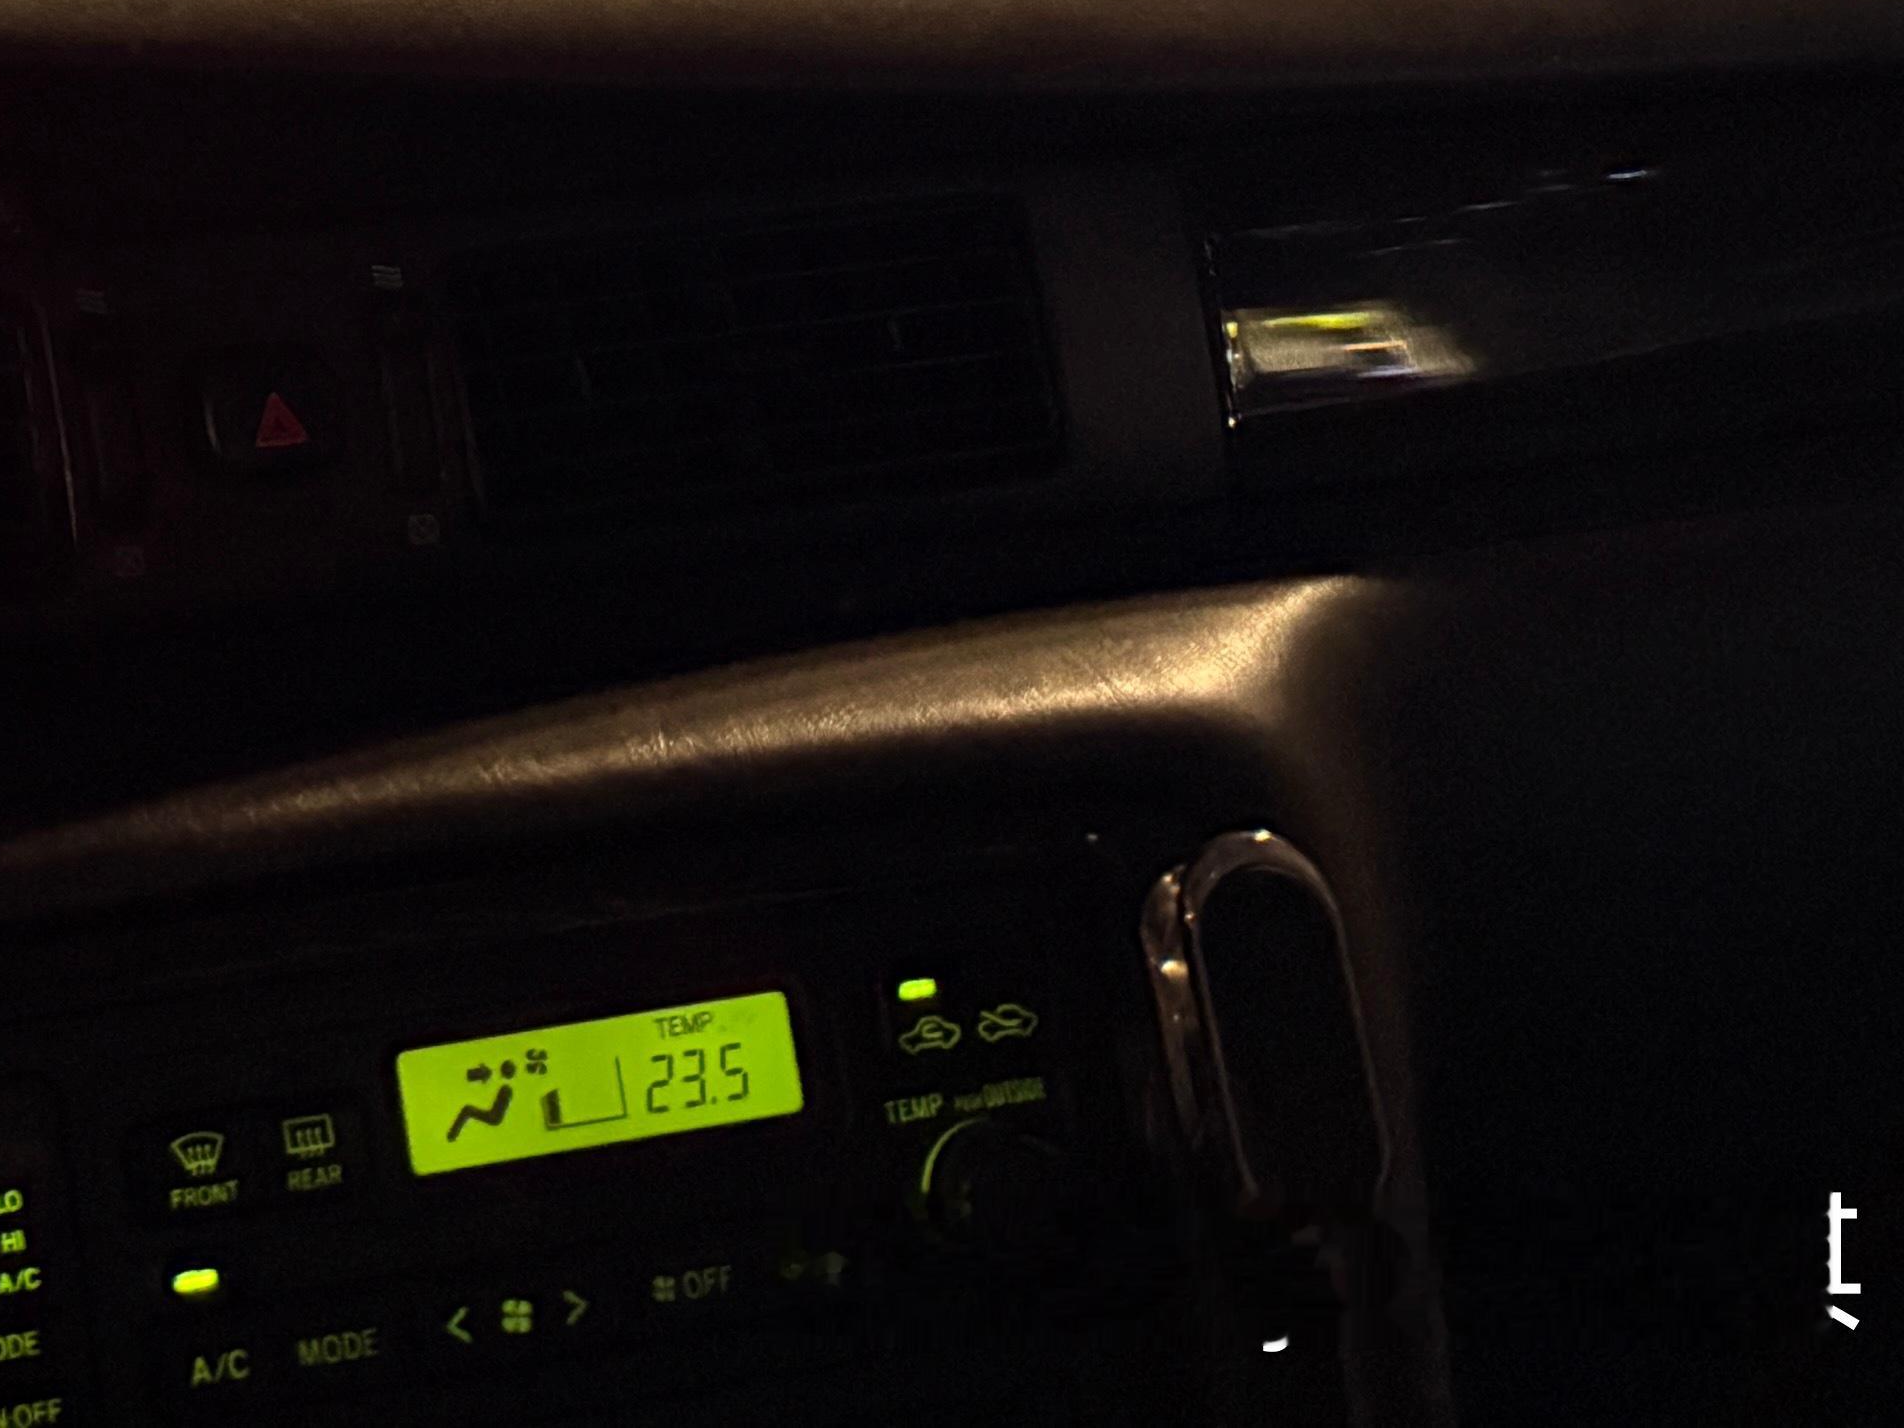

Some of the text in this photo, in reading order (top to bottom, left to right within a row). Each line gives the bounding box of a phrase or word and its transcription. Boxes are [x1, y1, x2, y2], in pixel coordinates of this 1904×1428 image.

[654, 1013, 713, 1039] TEMP
[644, 1042, 750, 1114] 23.5
[884, 1092, 943, 1123] TEMP
[288, 1164, 341, 1190] REAR
[170, 1181, 237, 1207] FRONT
[1, 1230, 25, 1252] HI
[682, 1264, 732, 1299] OFF
[298, 1329, 380, 1365] MODE
[193, 1350, 249, 1384] A/C
